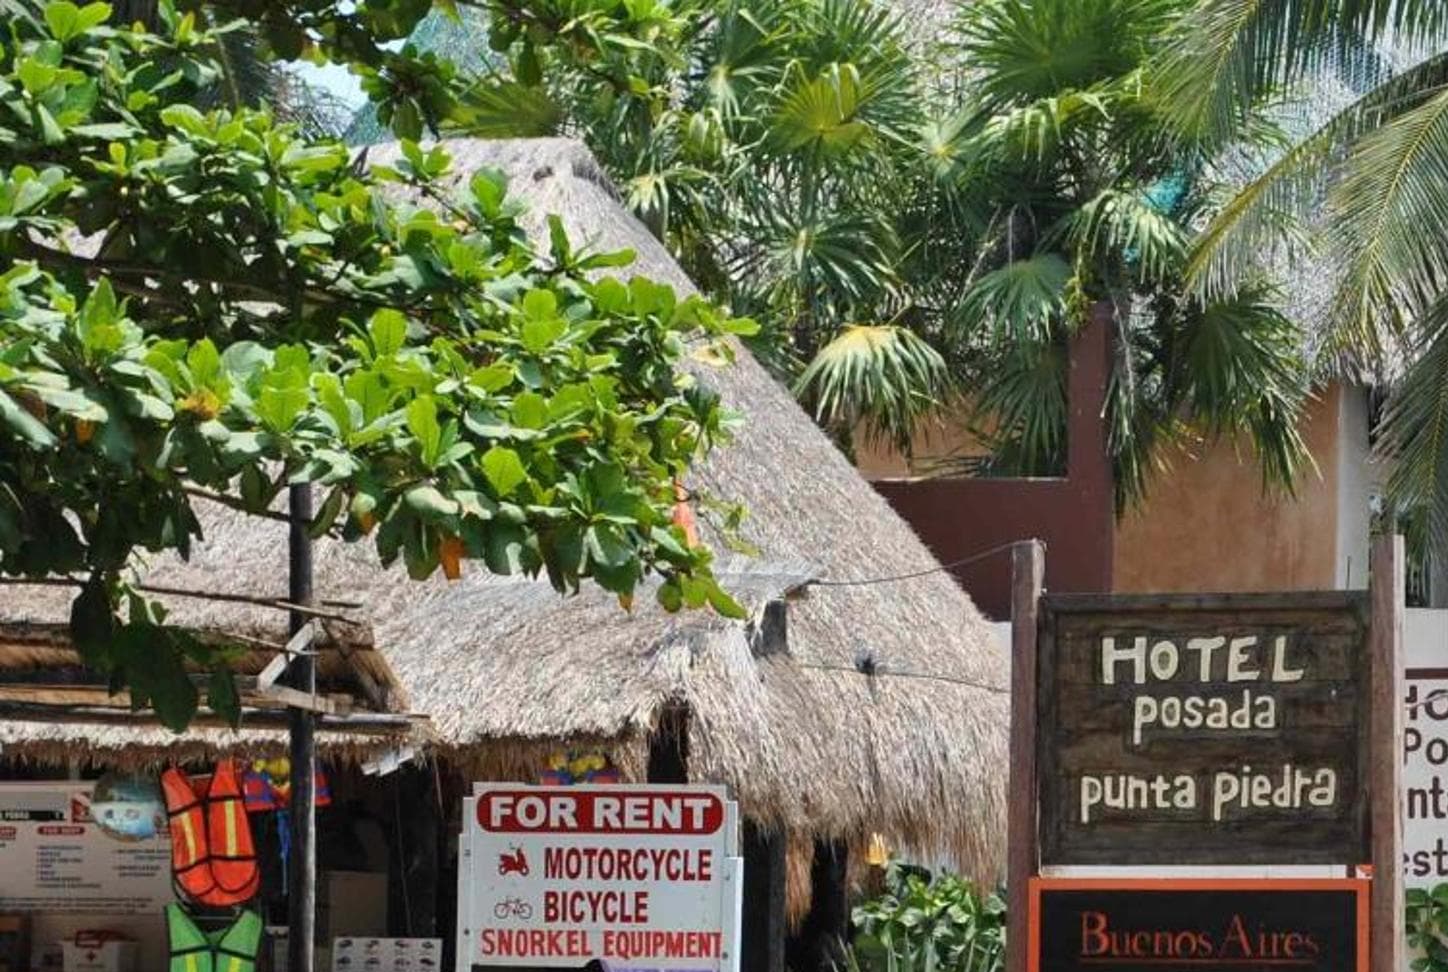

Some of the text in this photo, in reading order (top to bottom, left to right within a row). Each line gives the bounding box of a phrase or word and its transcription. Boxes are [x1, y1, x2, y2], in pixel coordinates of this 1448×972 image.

[1101, 635, 1305, 685] HOTEL
[1133, 689, 1276, 746] posada
[490, 796, 713, 829] FOR RENT
[1080, 764, 1336, 824] punta piedra
[543, 847, 712, 881] MOTORCYCLE
[543, 891, 649, 923] BICYCLE
[481, 929, 722, 959] SNORKEL EQUIPMENT
[1080, 911, 1320, 958] Buenos Aires
